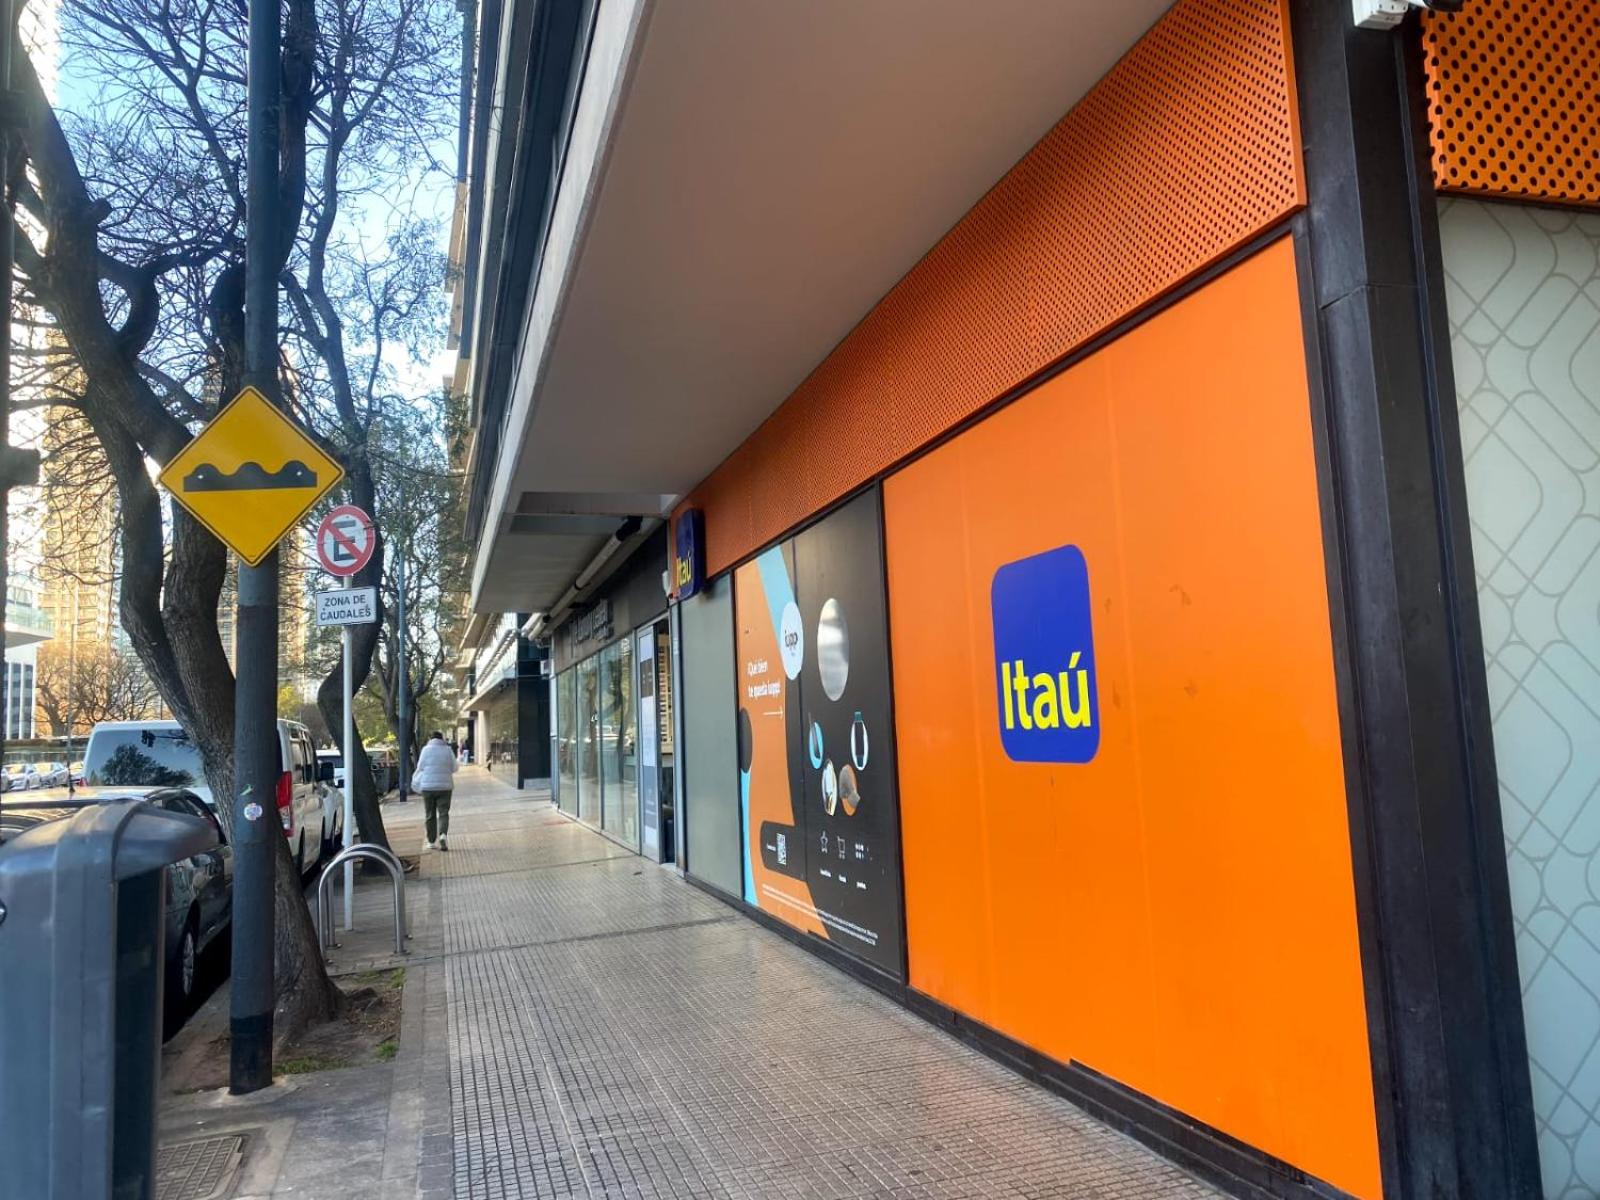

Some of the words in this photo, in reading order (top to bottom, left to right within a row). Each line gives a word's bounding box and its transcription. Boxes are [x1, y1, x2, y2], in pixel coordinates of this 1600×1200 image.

[324, 596, 351, 608] ZONA
[353, 594, 366, 604] DE
[320, 606, 372, 621] CAUDALES
[1001, 651, 1092, 731] Itaú
